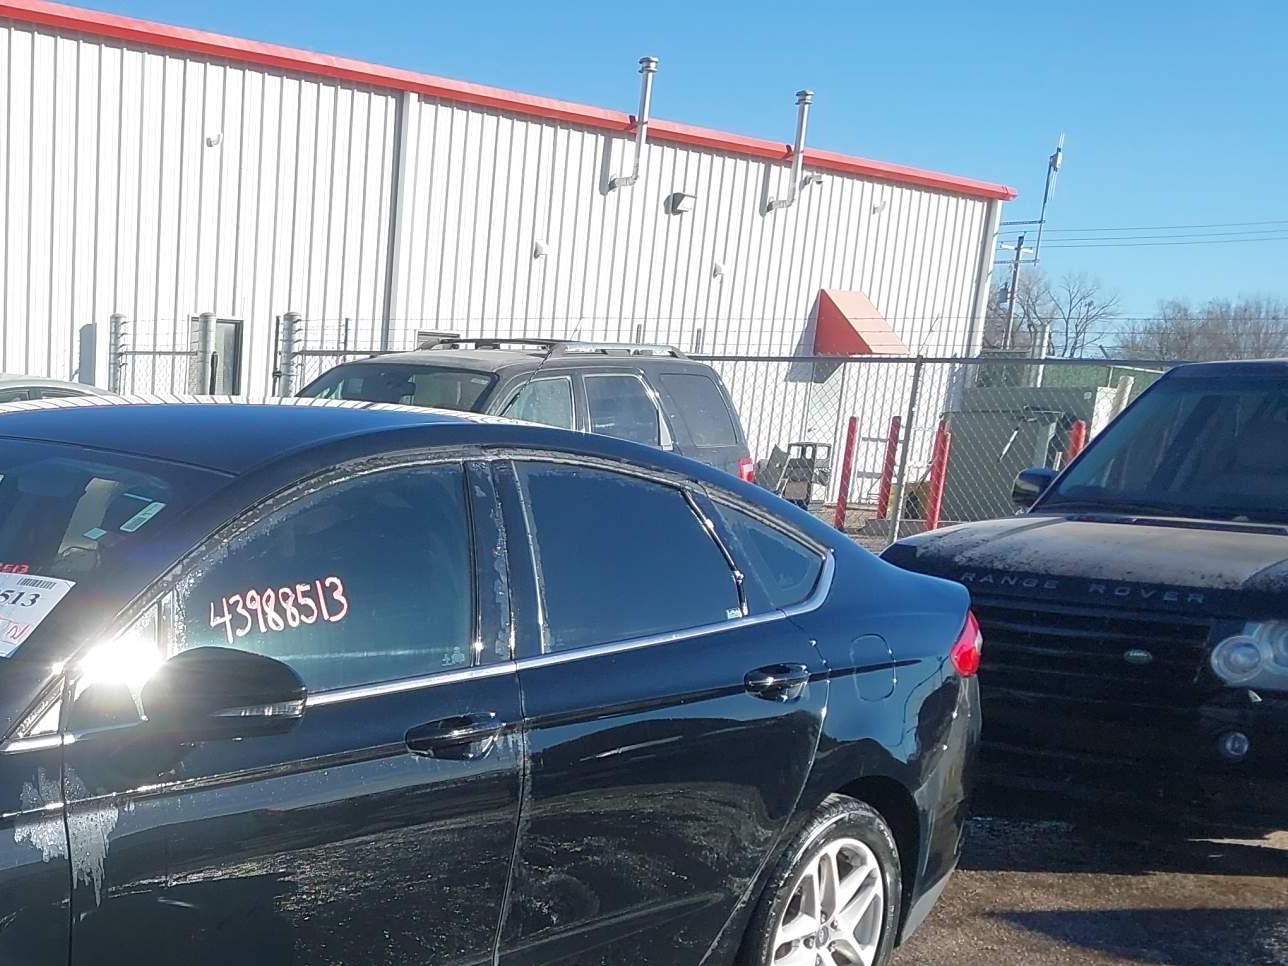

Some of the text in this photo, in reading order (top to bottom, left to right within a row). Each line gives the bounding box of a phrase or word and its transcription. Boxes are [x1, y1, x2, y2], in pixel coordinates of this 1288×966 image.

[210, 576, 348, 644] 43988513
[961, 572, 1204, 604] RANGE ROVER
